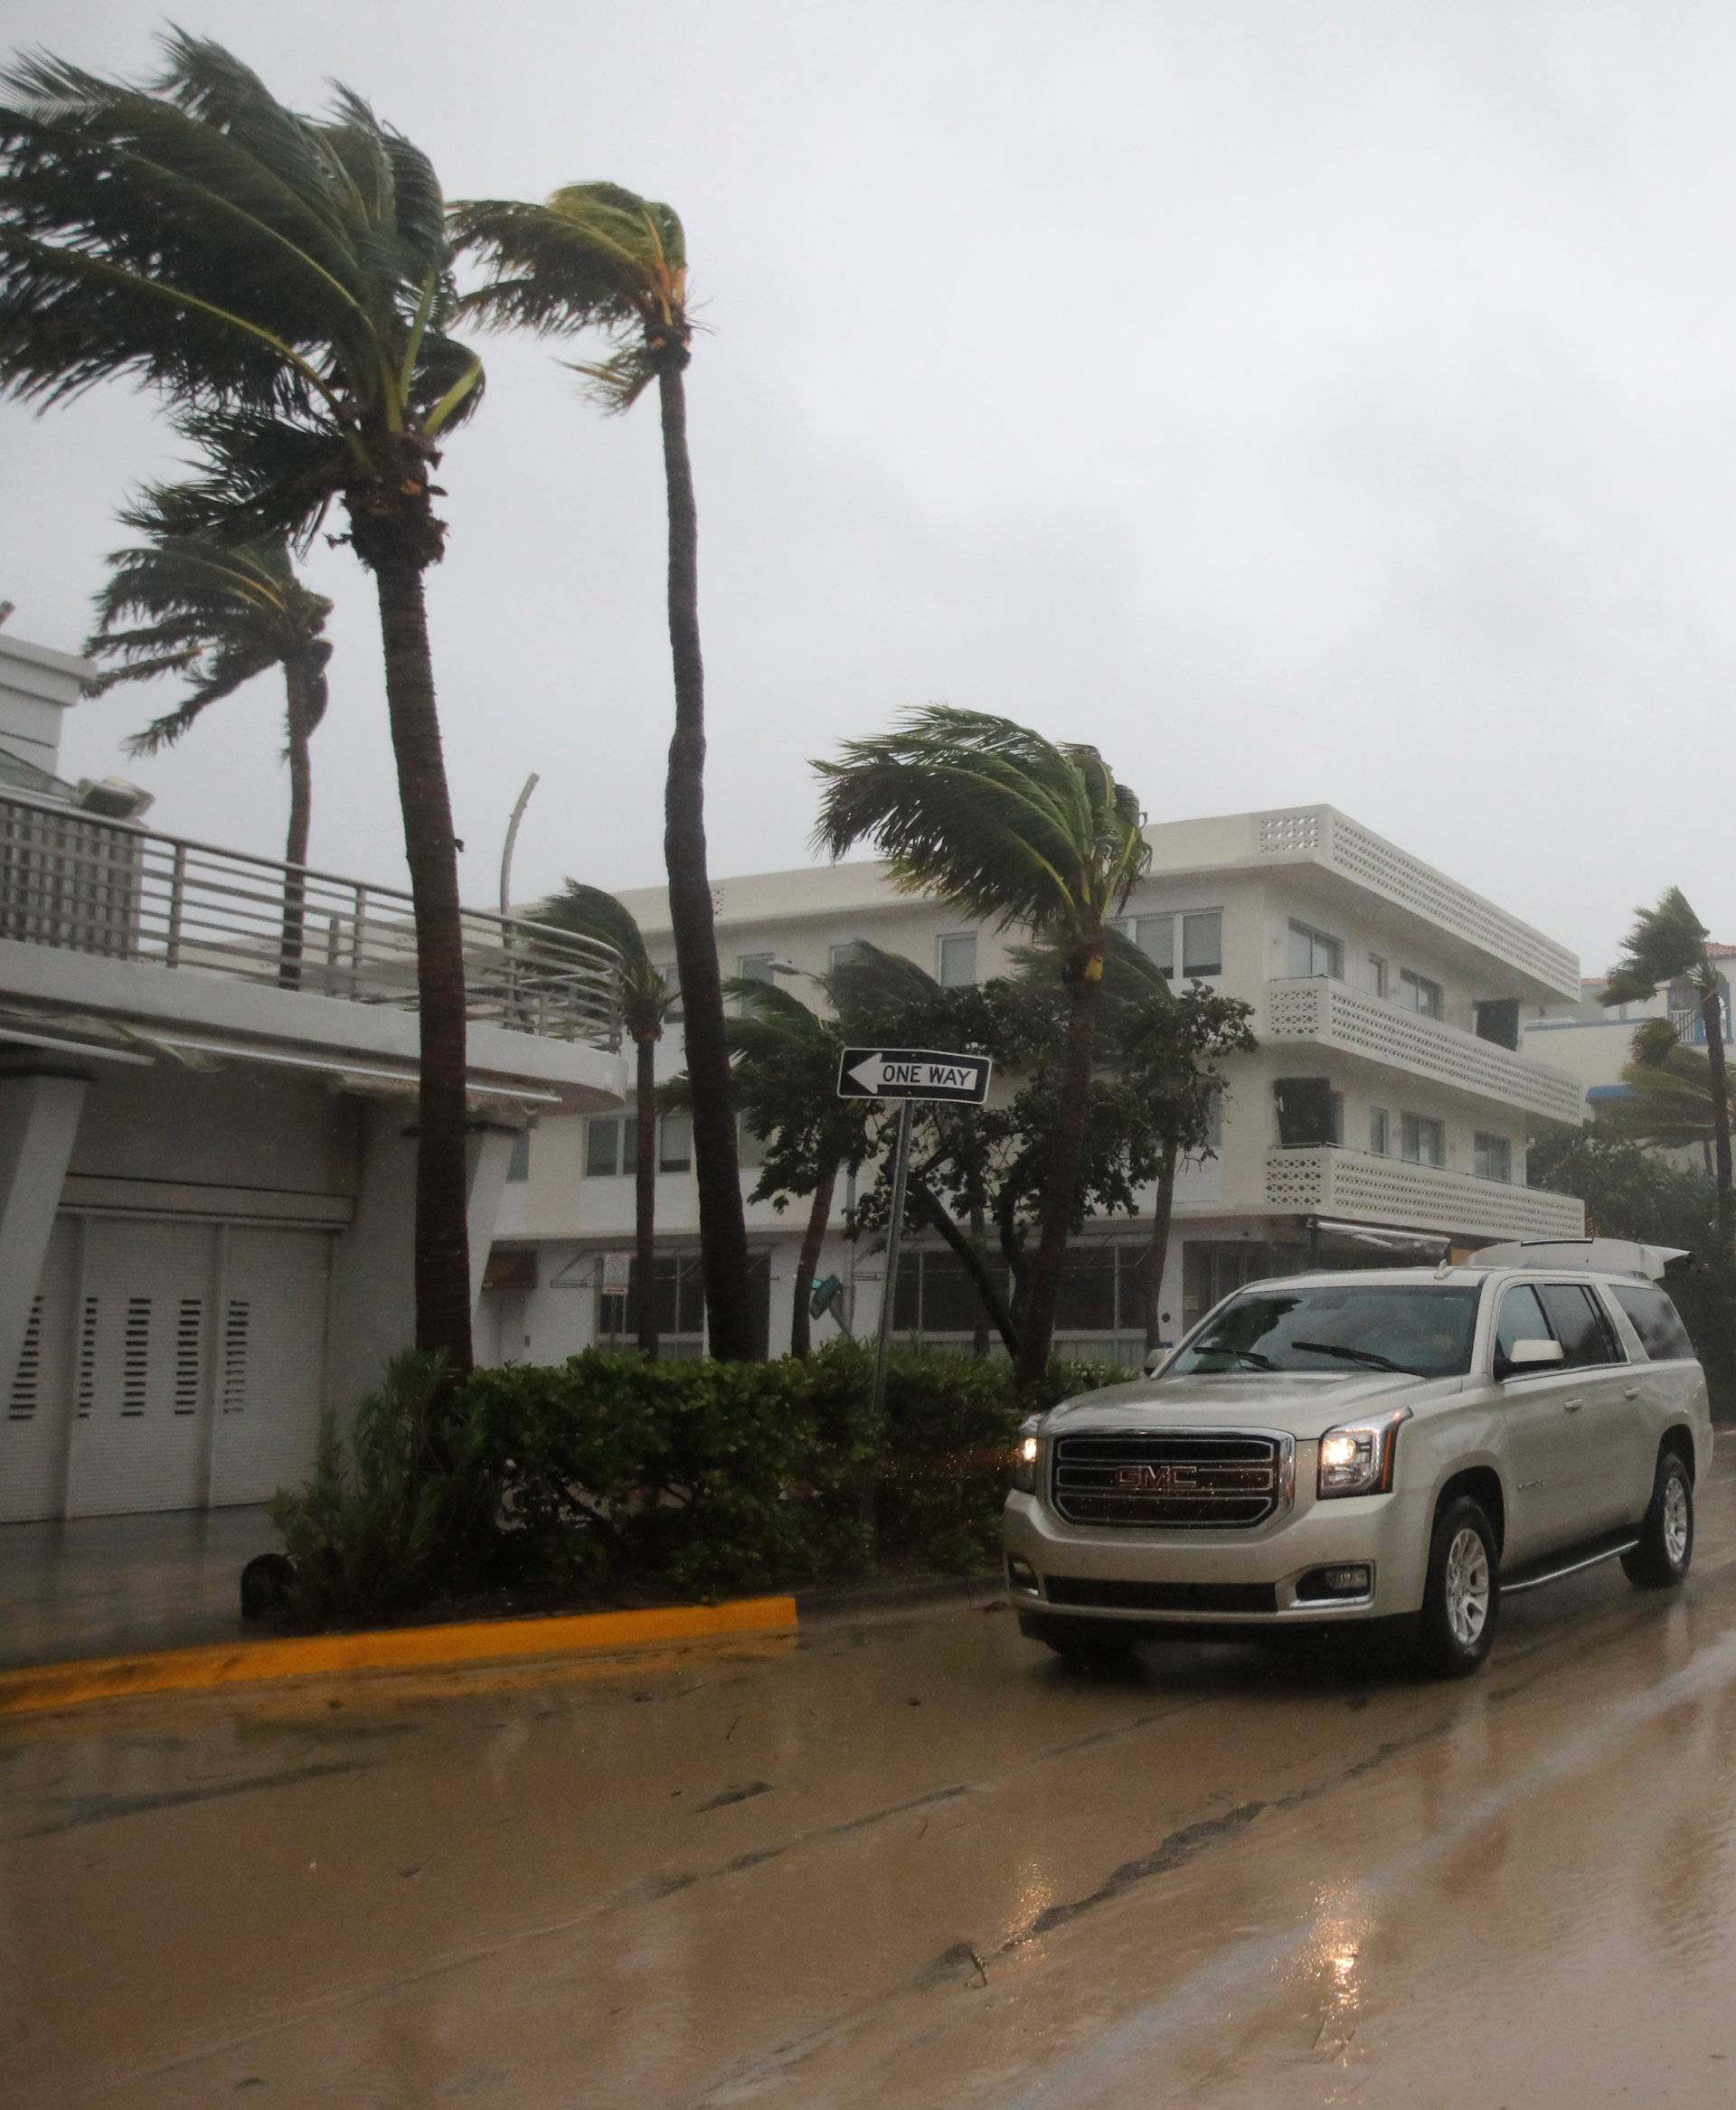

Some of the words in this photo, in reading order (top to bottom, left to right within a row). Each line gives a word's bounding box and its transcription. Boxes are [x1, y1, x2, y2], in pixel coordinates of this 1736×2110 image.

[882, 1065, 922, 1083] ONE
[929, 1067, 971, 1087] WAY
[1114, 1465, 1198, 1490] GMC
